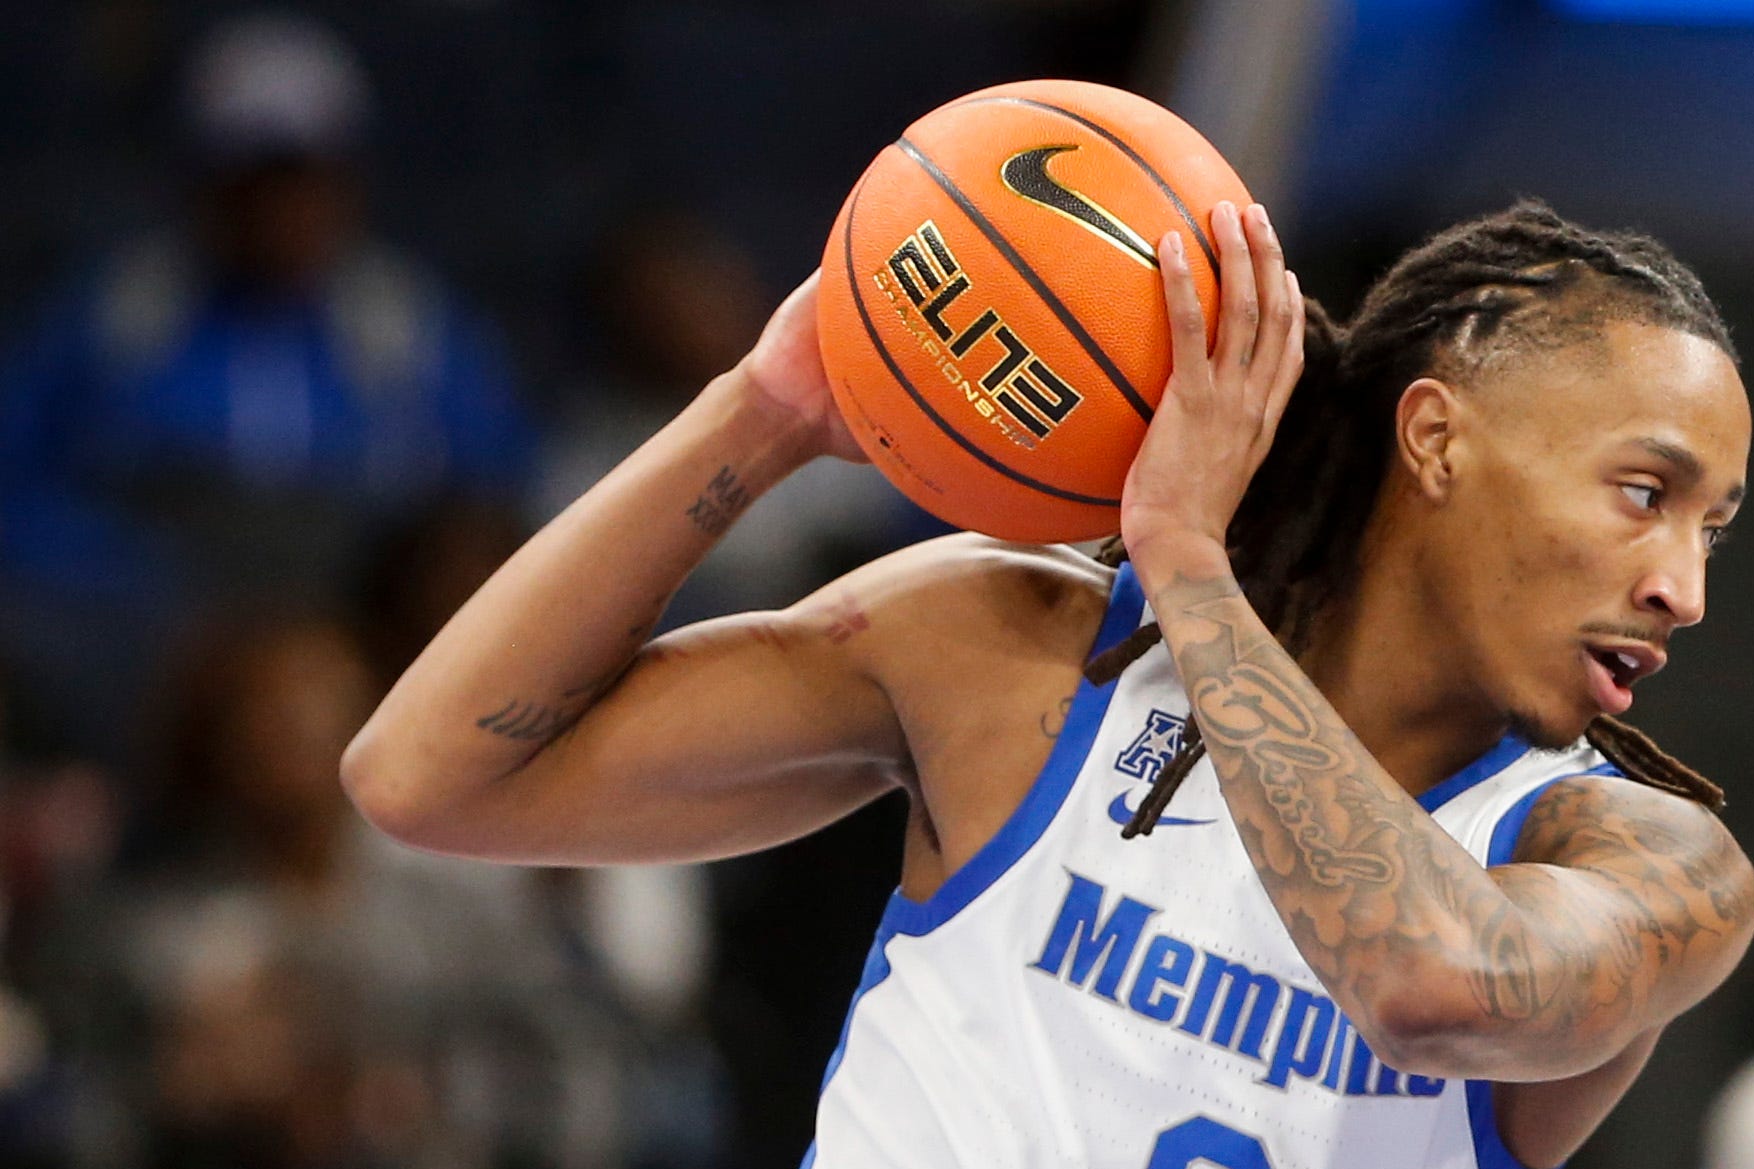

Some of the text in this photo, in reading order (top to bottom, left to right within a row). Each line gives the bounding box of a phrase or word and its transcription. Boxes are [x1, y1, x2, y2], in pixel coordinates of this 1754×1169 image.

[873, 268, 1036, 451] CHAMPIONSHIP
[886, 219, 1085, 442] ELITE
[1194, 662, 1395, 884] Blessed
[1027, 866, 1446, 1098] Memph
